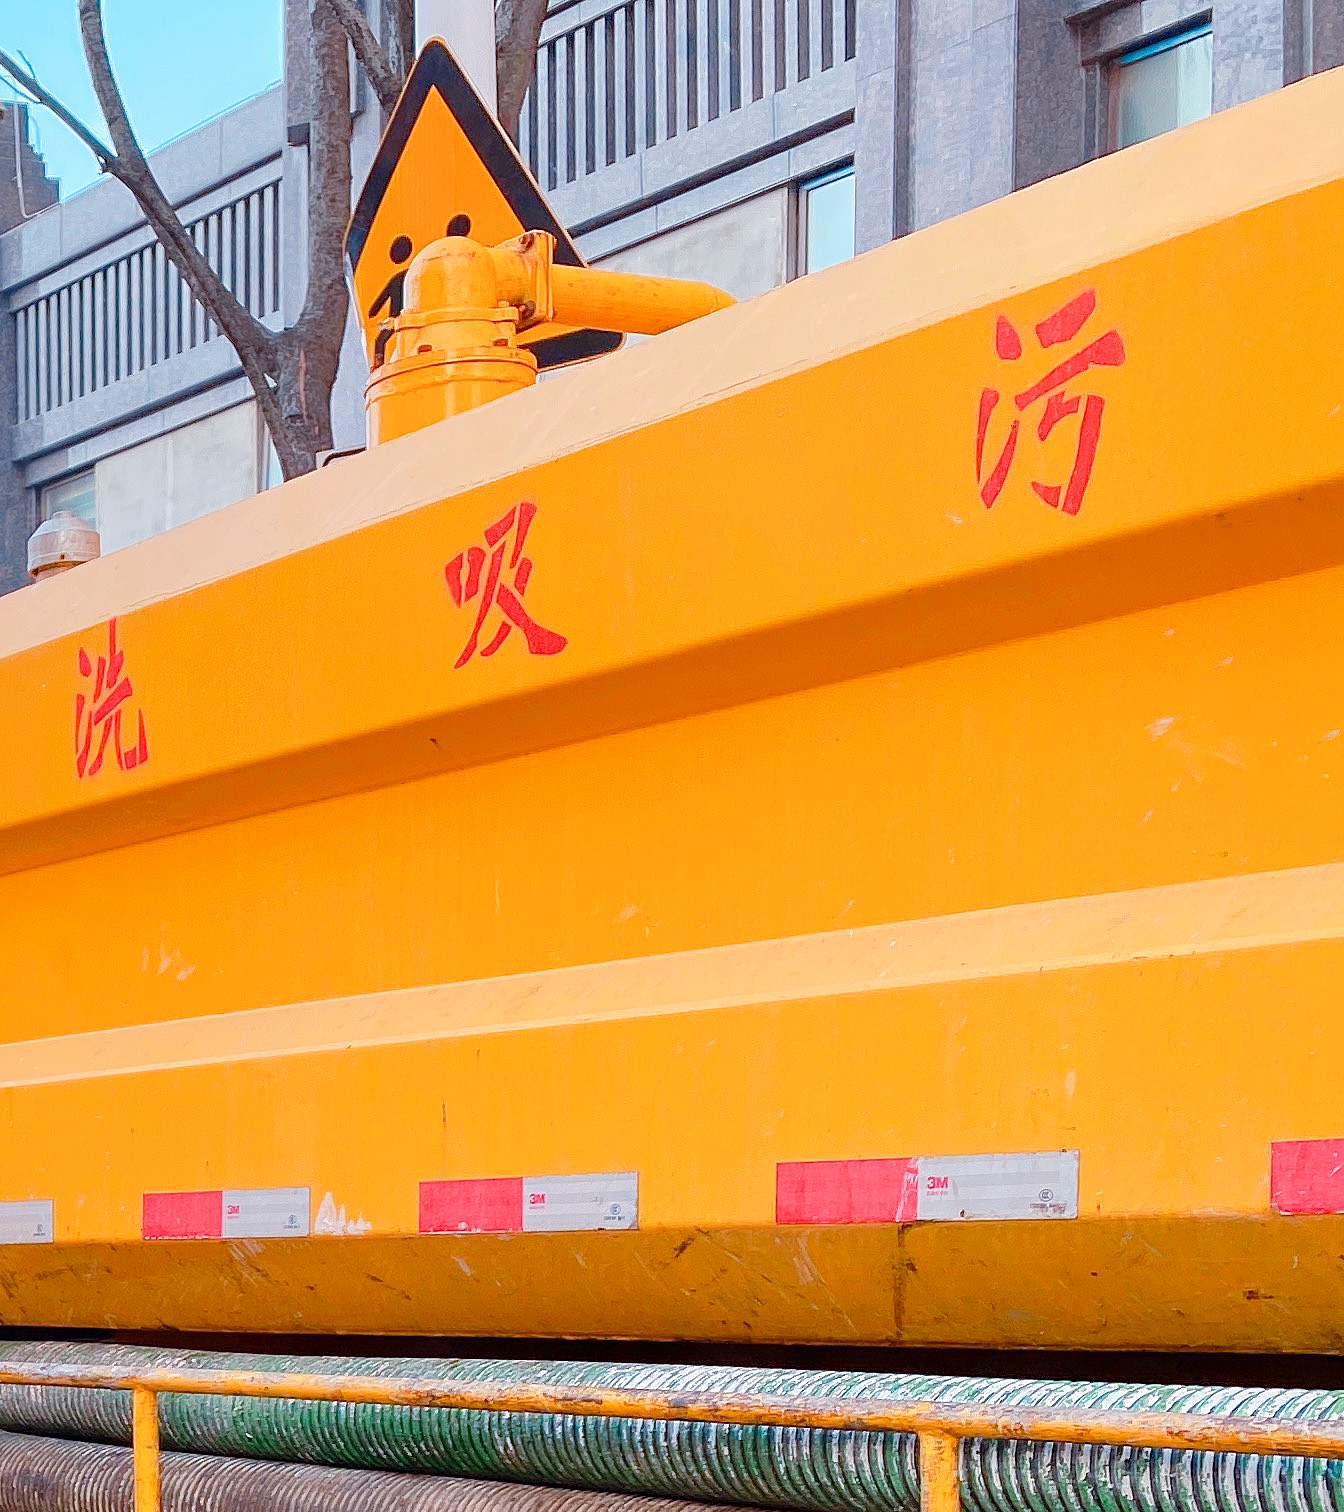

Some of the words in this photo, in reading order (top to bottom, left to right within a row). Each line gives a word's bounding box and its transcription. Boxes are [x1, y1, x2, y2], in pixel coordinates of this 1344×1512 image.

[926, 1178, 949, 1189] 3M
[528, 1194, 545, 1204] 3M
[227, 1205, 240, 1215] 3M
